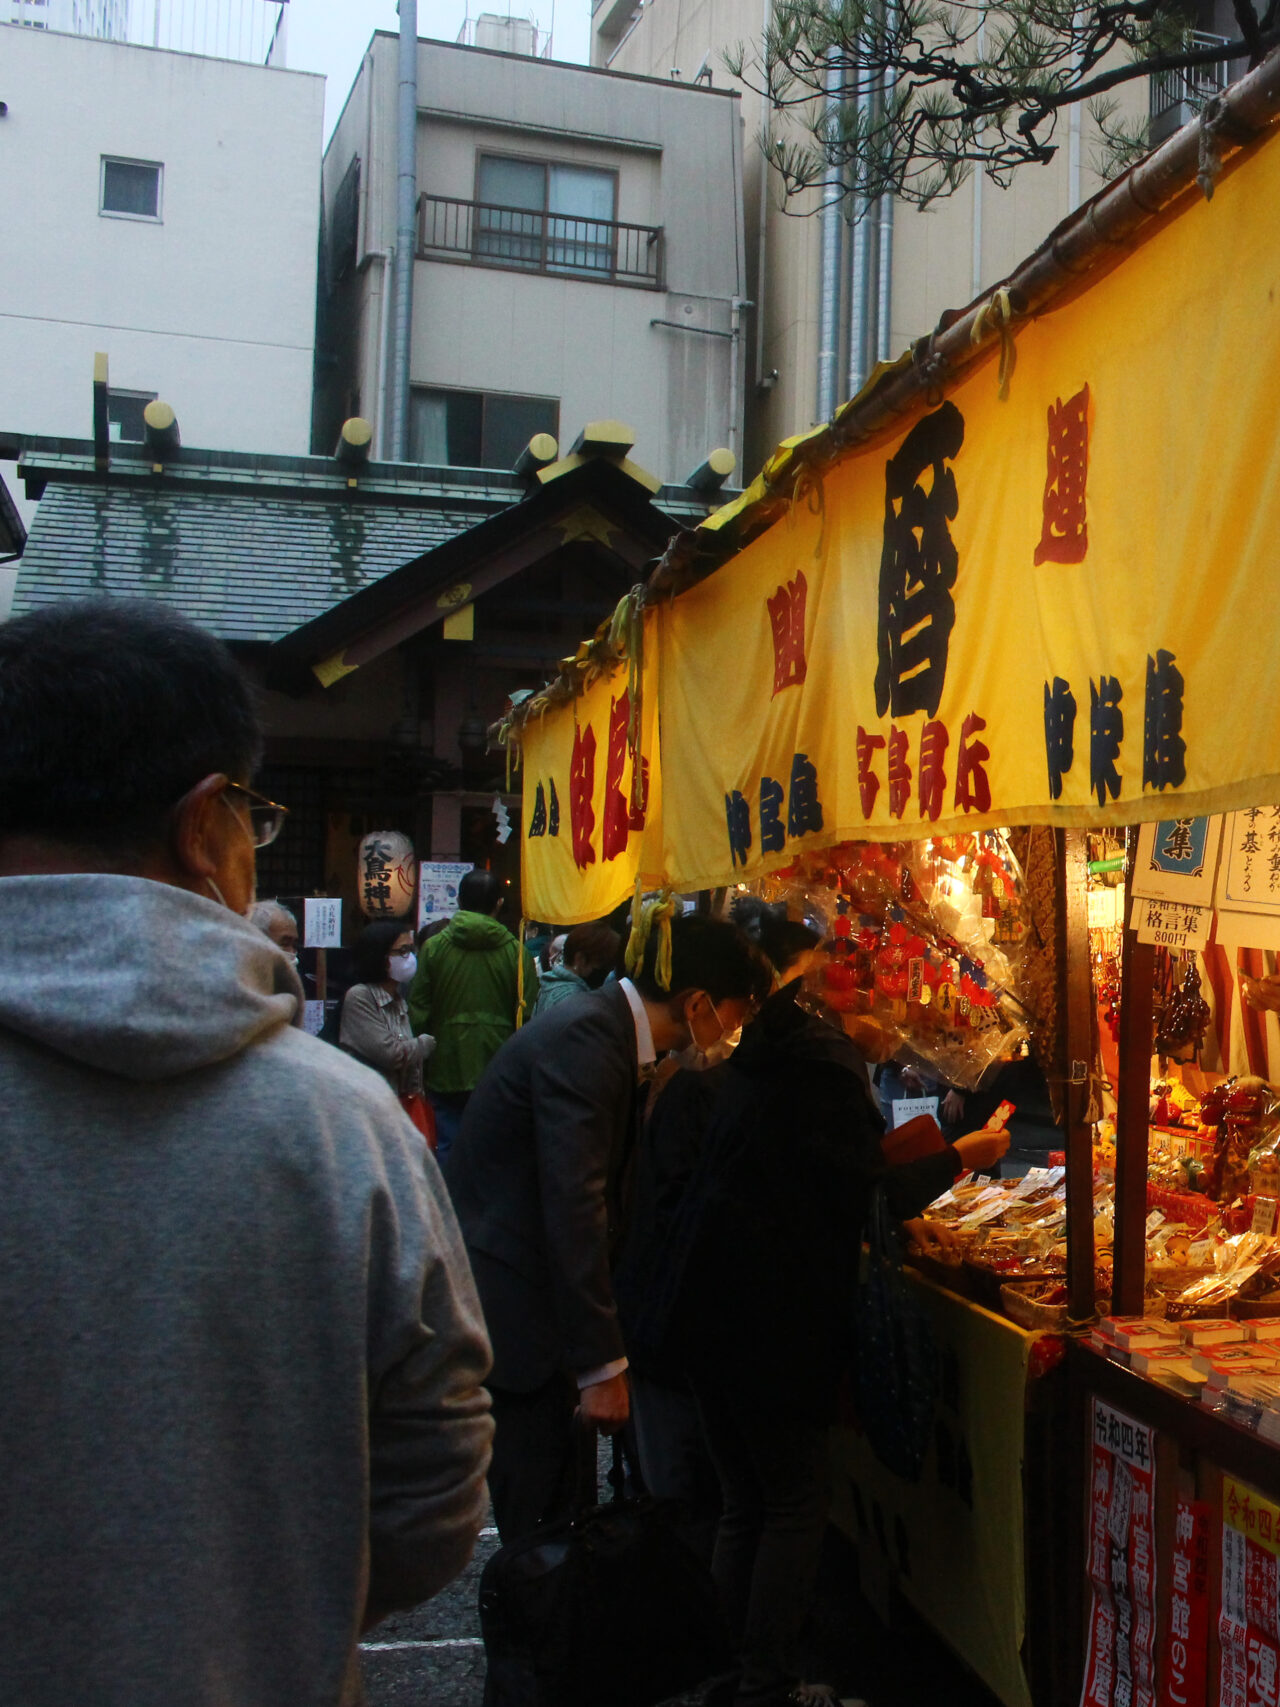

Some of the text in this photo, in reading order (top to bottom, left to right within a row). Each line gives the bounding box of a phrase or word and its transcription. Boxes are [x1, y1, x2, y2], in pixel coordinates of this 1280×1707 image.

[364, 840, 394, 914] 大鳥神社
[1146, 910, 1198, 933] 格言集
[1154, 930, 1187, 946] 800円
[1096, 1407, 1149, 1467] 令和四年
